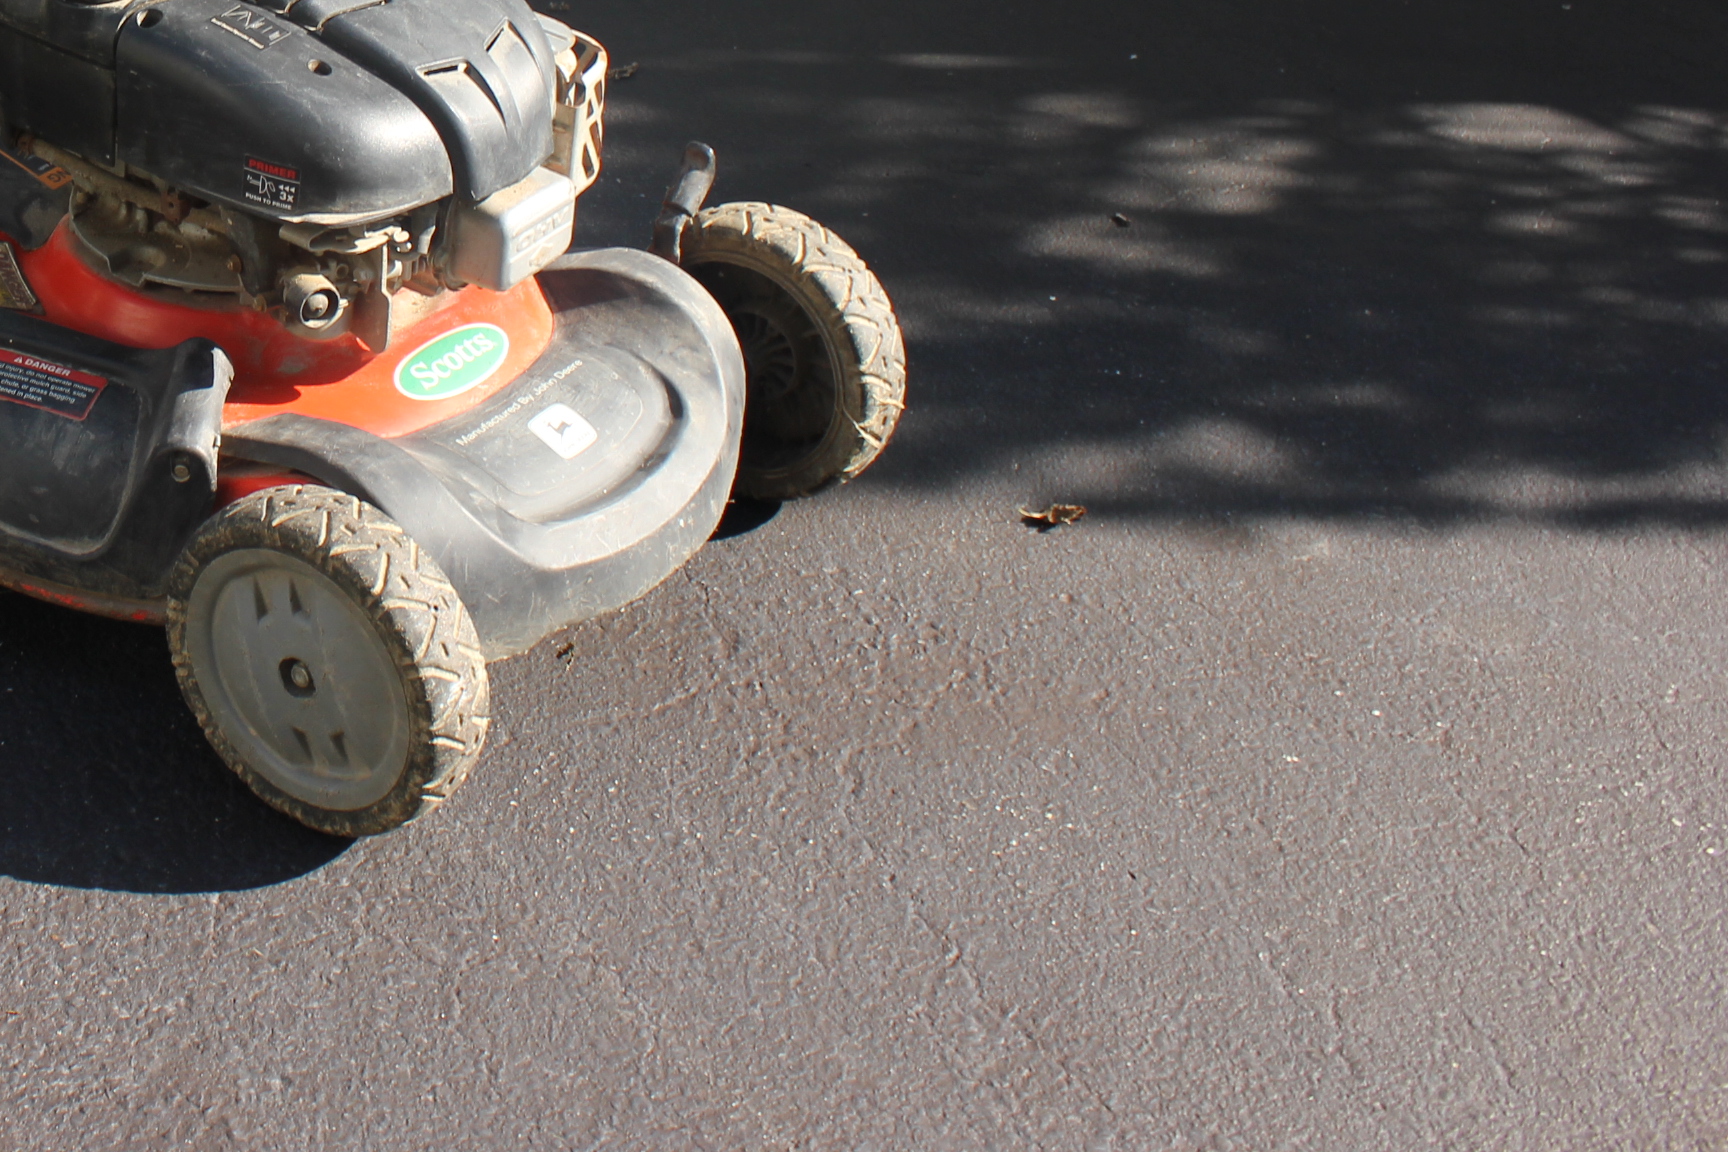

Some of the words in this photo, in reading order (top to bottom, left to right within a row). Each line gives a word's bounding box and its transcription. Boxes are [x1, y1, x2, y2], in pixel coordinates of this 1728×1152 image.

[248, 159, 297, 179] PRIMER
[245, 192, 262, 202] PUSH
[272, 201, 292, 210] PRIME
[24, 358, 71, 377] DANGER
[410, 332, 496, 390] Scotts
[5, 363, 25, 375] injury,
[26, 369, 36, 377] do
[36, 371, 47, 380] not
[48, 375, 72, 387] operate
[73, 383, 96, 393] mower
[29, 377, 50, 387] mulch
[72, 388, 87, 398] side
[29, 386, 48, 396] grass
[48, 388, 76, 404] bagging
[455, 402, 521, 447] Manufactured
[518, 393, 535, 406] By
[533, 377, 558, 396] John
[553, 359, 583, 380] Deere
